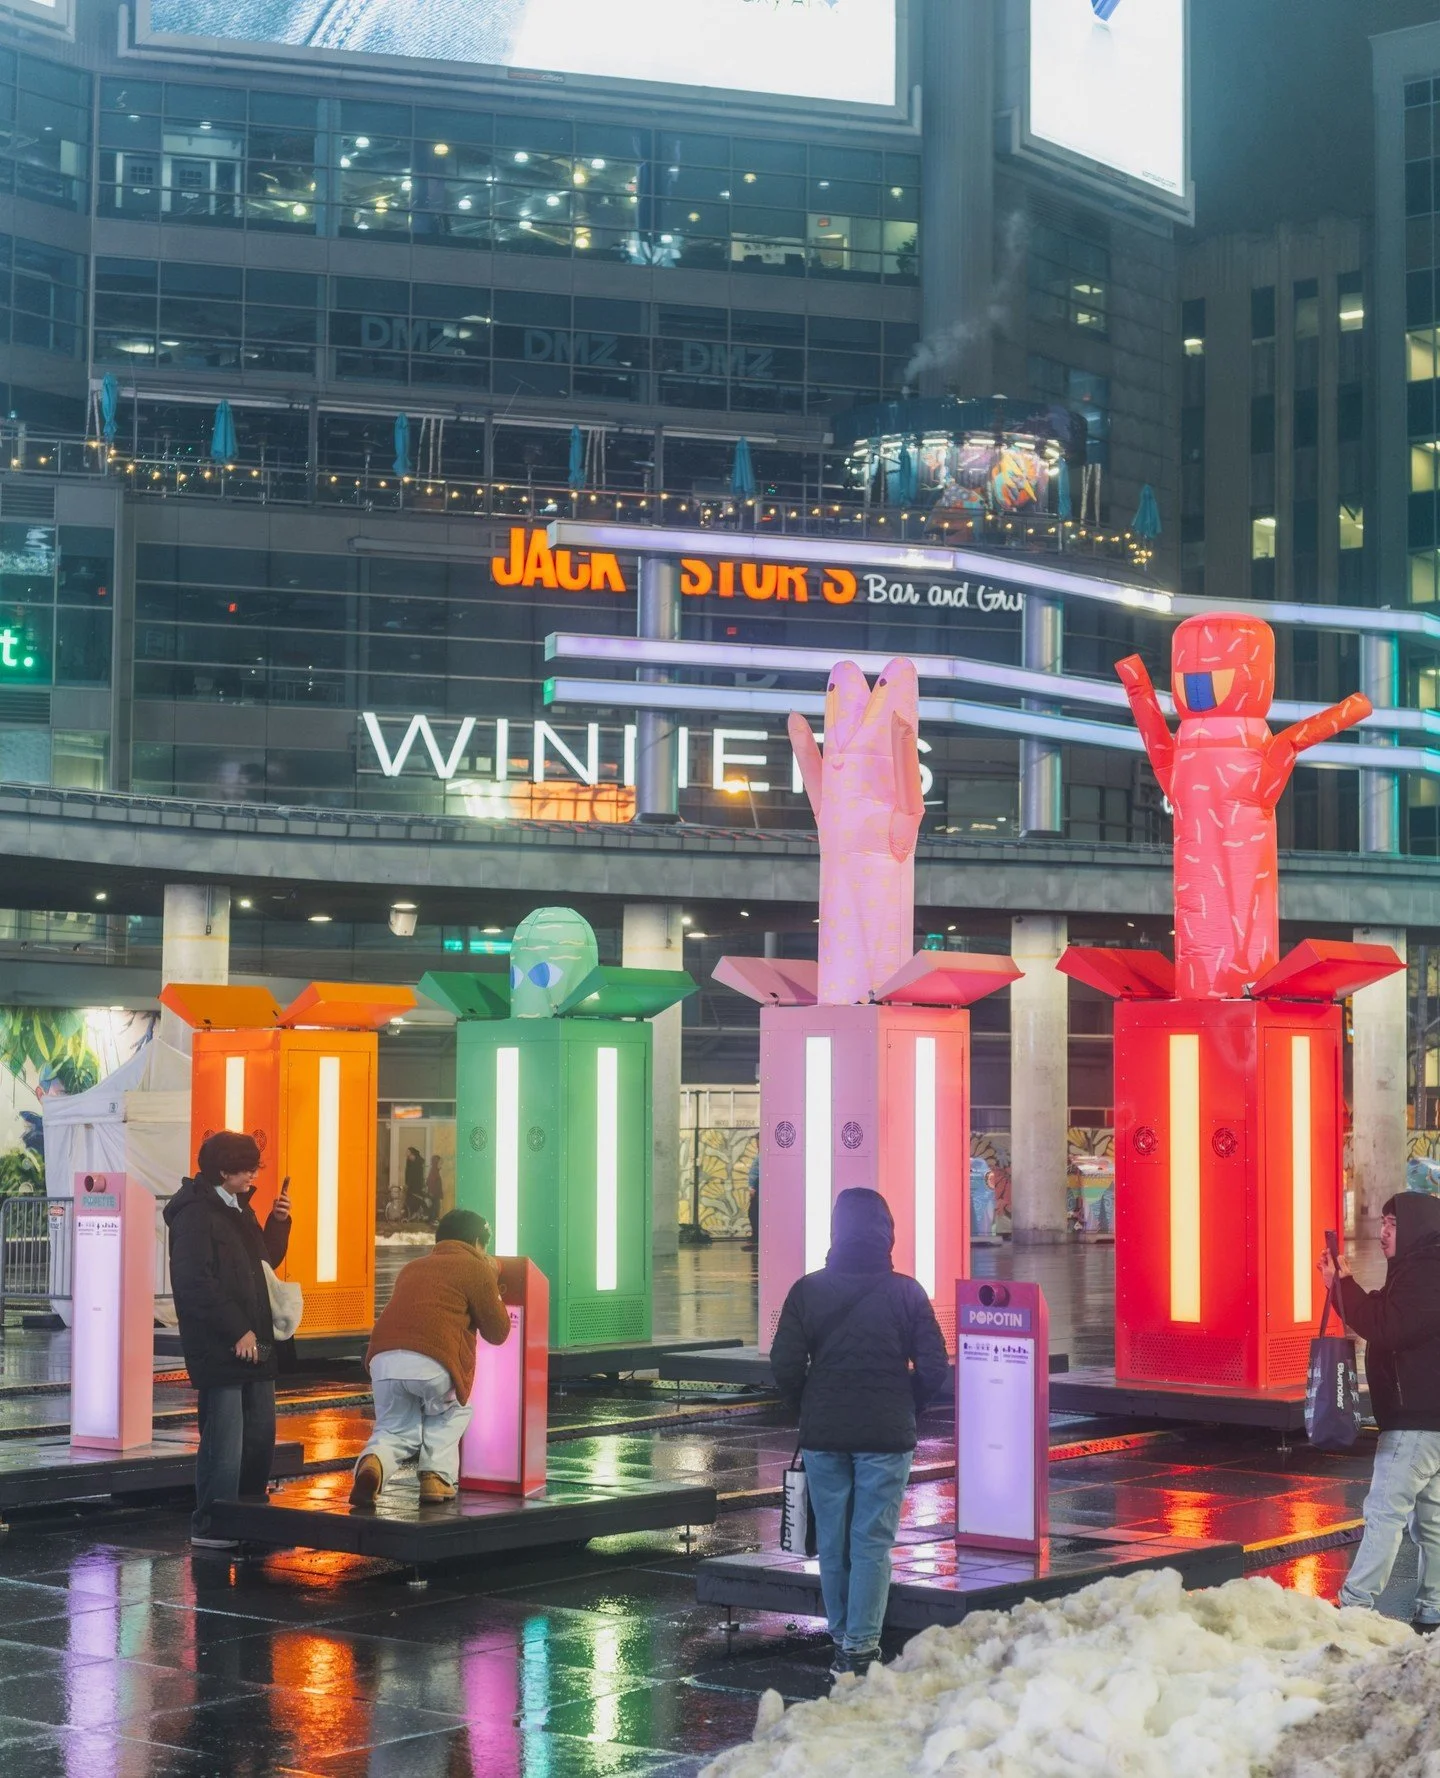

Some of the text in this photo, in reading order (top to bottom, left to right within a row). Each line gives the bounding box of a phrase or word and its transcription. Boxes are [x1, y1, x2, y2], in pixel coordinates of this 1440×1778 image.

[361, 315, 458, 353] DMZ
[523, 329, 619, 367] DMZ
[682, 341, 774, 379] DMZ
[863, 573, 920, 605] Bar
[928, 582, 970, 607] and
[969, 1310, 1023, 1327] POPOTIN
[1337, 1362, 1345, 1408] Bluenotes
